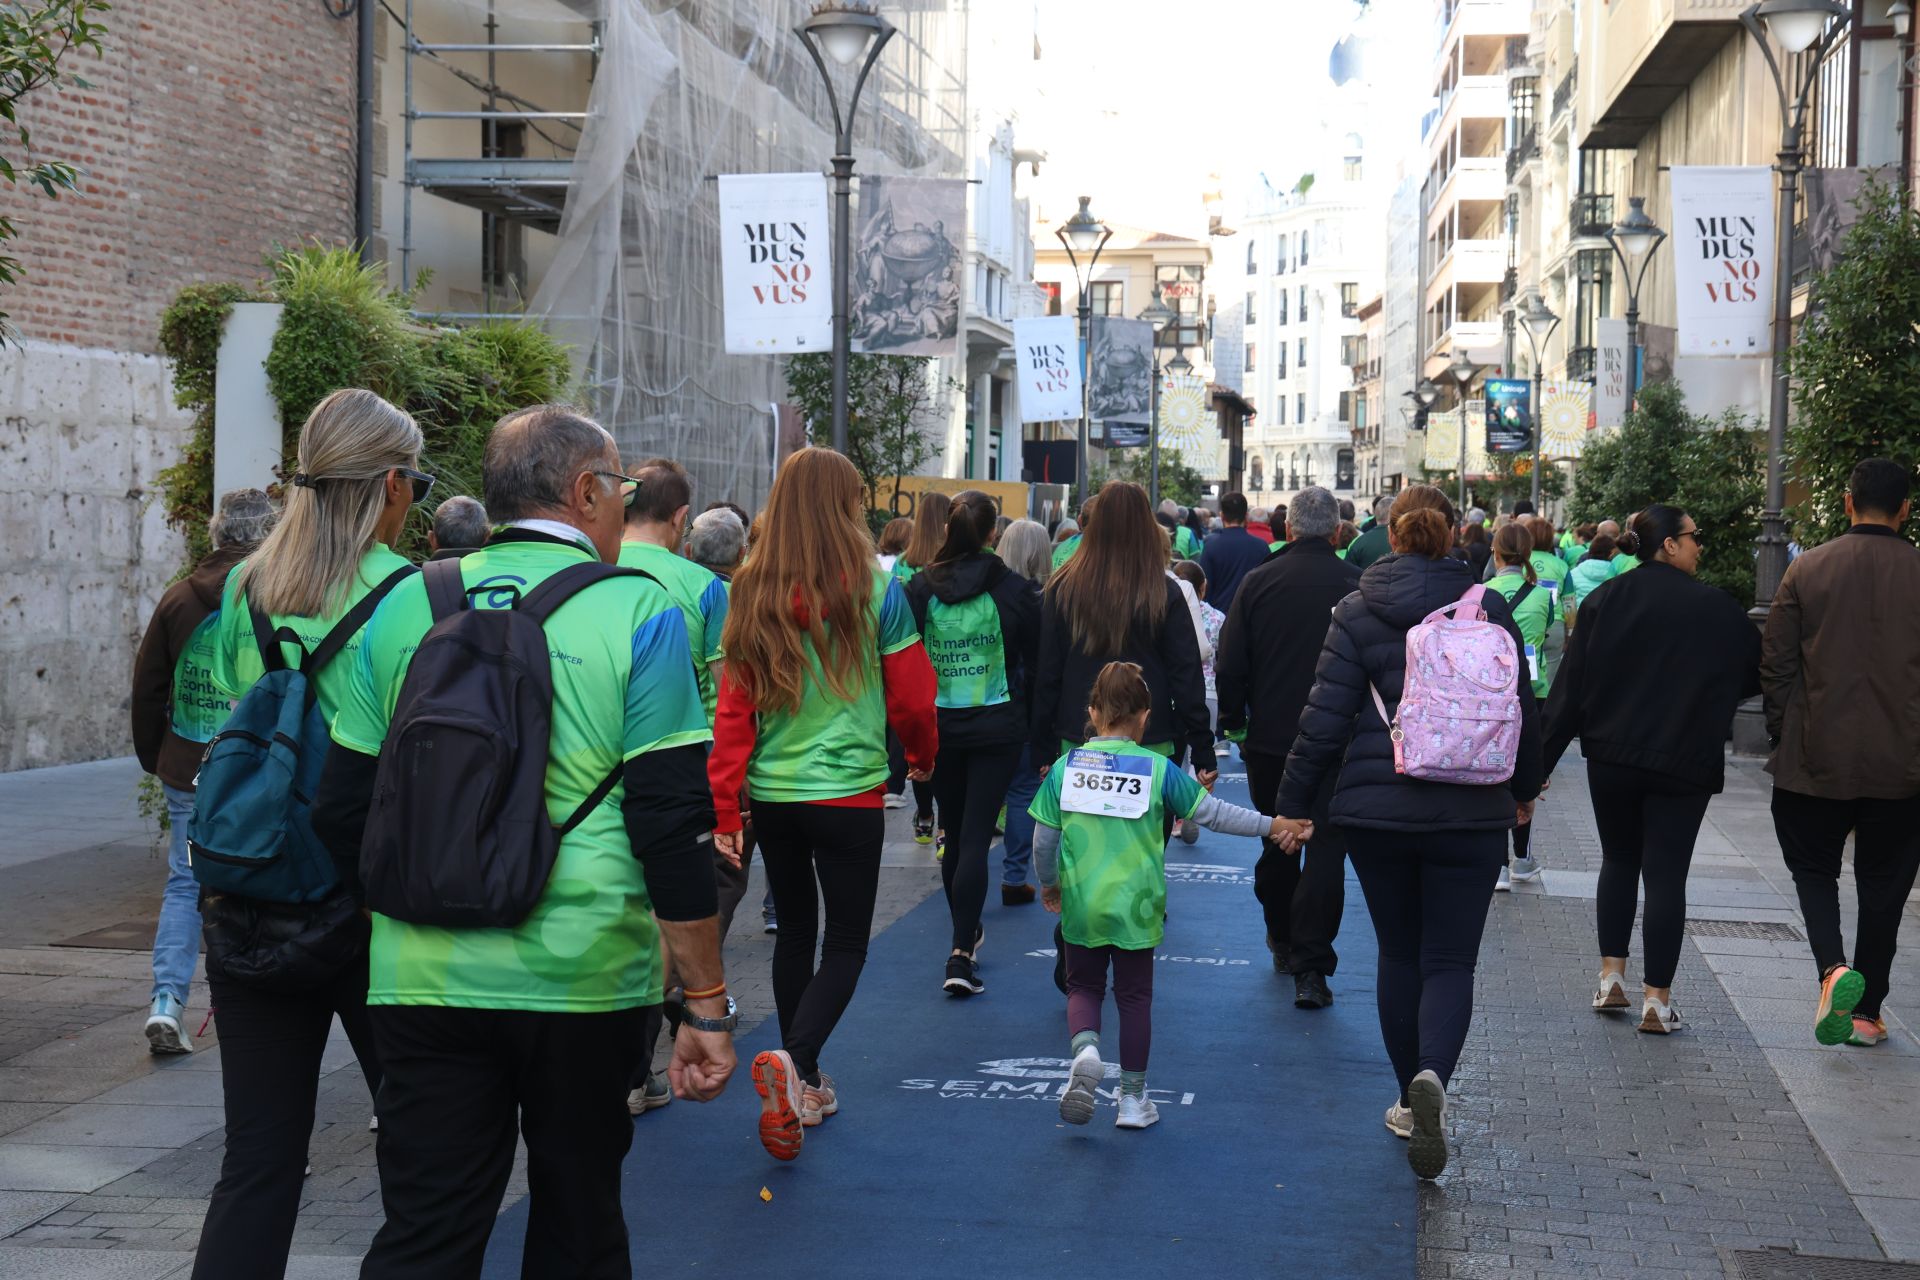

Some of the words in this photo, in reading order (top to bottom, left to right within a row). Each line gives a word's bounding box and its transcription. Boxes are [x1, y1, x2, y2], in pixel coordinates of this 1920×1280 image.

[743, 222, 807, 243] MUN
[1694, 215, 1756, 238] MUN
[750, 243, 805, 264] DUS
[1702, 238, 1755, 260] DUS
[771, 263, 812, 283] NO
[1723, 260, 1761, 281] NO
[752, 284, 807, 305] VUS
[1705, 282, 1757, 303] VUS
[1028, 344, 1065, 358] MUN
[1603, 347, 1622, 360] MUN
[1033, 357, 1065, 369] DUS
[1604, 360, 1621, 372] DUS
[1045, 368, 1070, 380] NO
[1035, 381, 1068, 393] VUS
[1604, 385, 1621, 398] VUS
[944, 633, 996, 650] marcha
[932, 652, 970, 664] contra
[943, 663, 990, 678] cáncer
[182, 693, 194, 706] el
[1072, 772, 1142, 796] 36573
[1153, 948, 1250, 965] icaja
